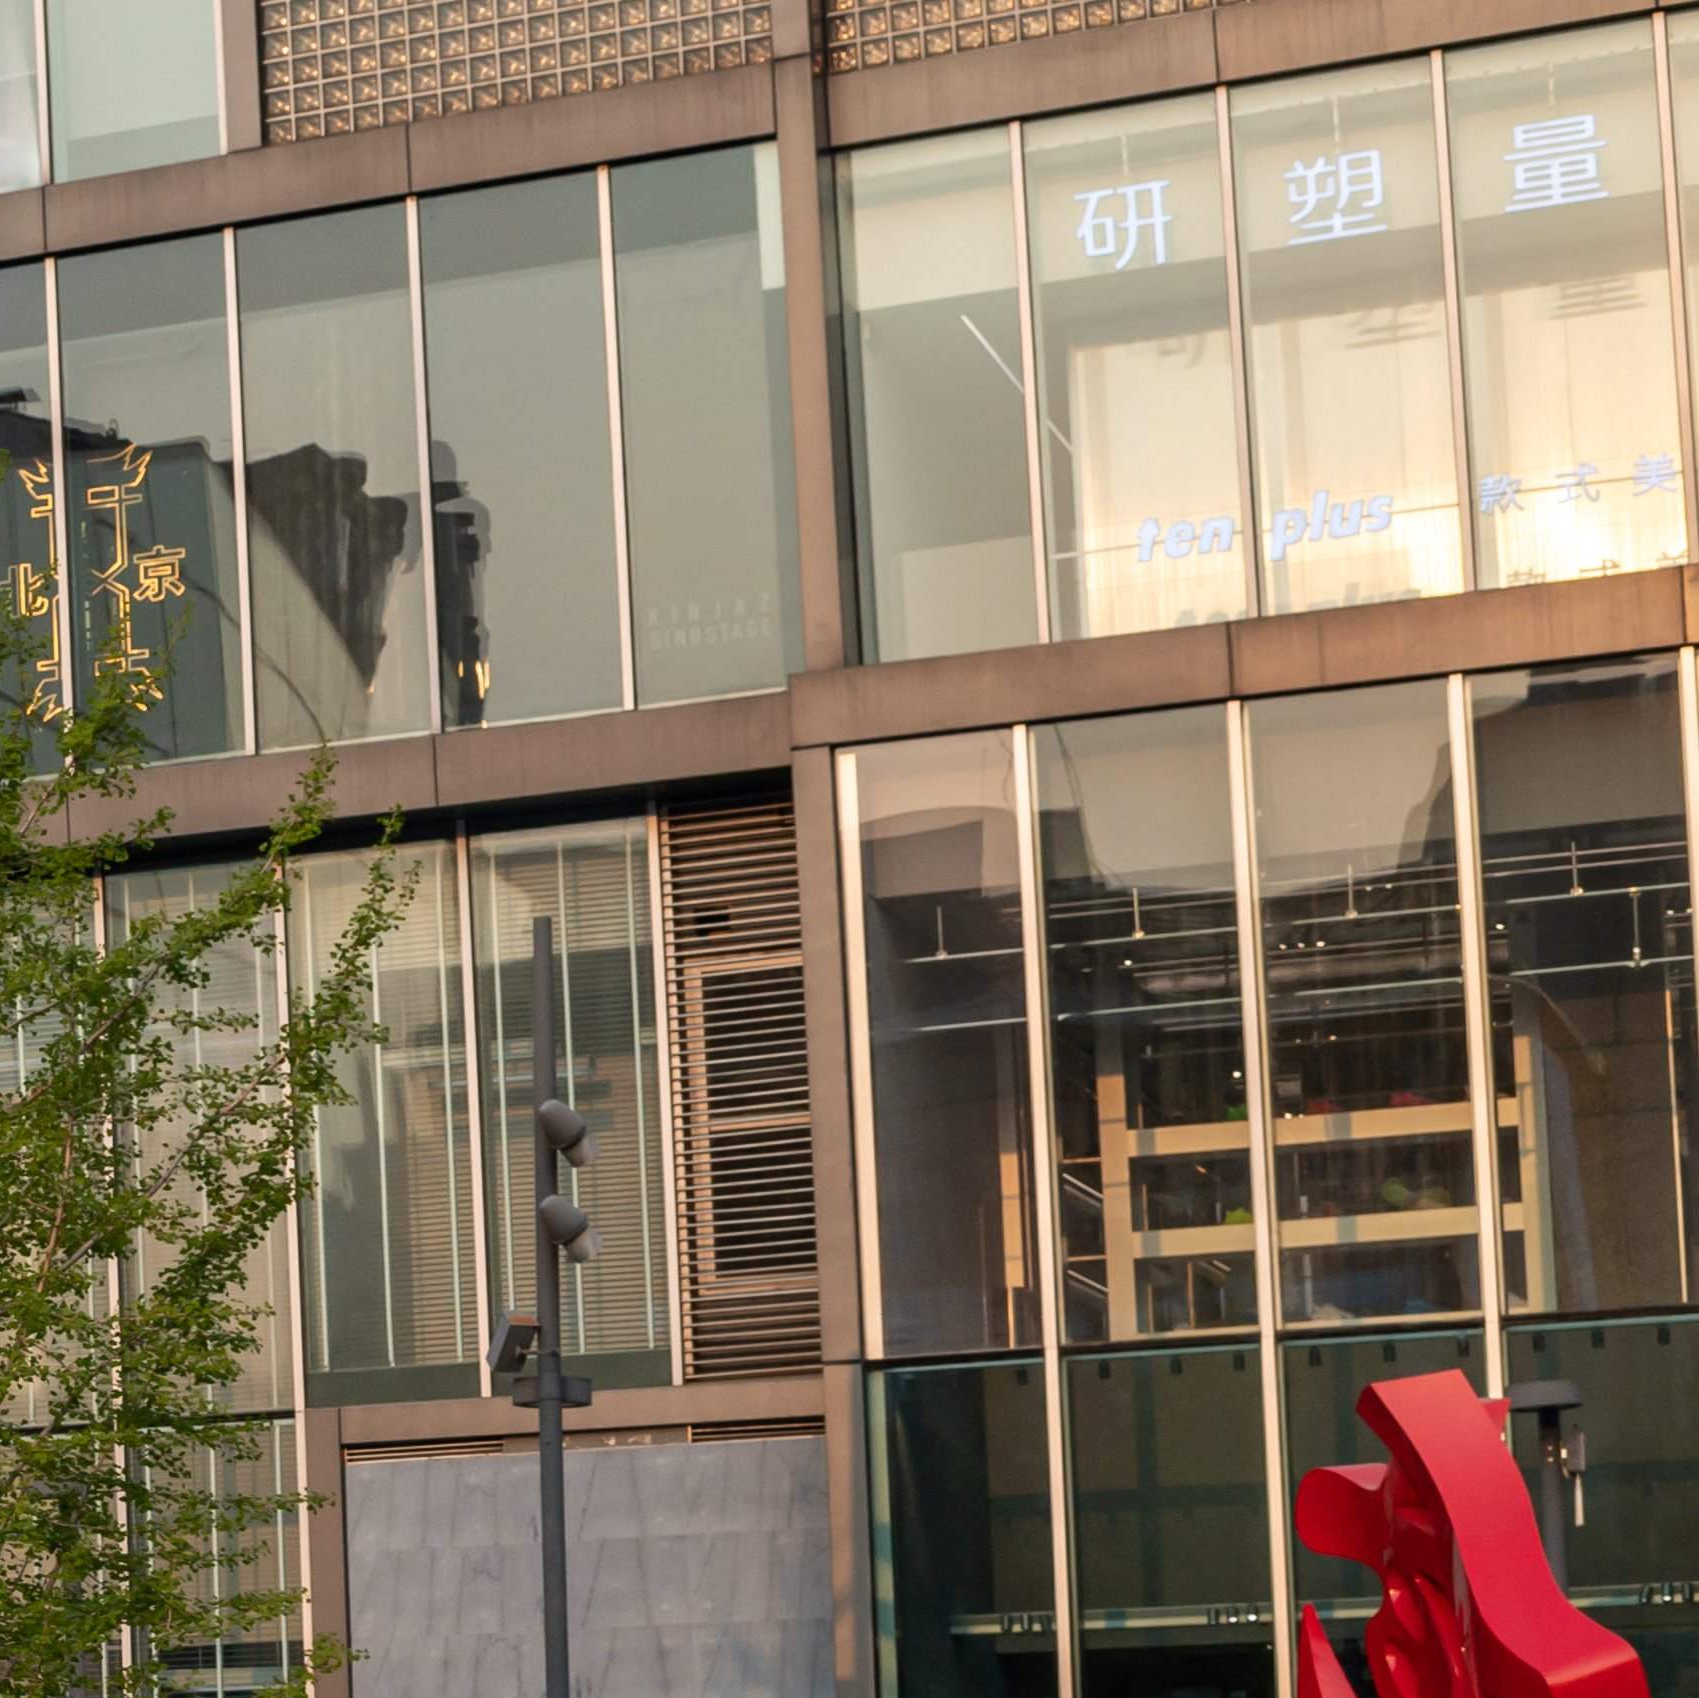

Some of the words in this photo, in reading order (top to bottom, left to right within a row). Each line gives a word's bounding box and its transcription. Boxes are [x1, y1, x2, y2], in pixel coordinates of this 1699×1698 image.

[1073, 113, 1611, 271] 研塑量
[1135, 513, 1236, 563] ten
[1270, 488, 1395, 562] plus
